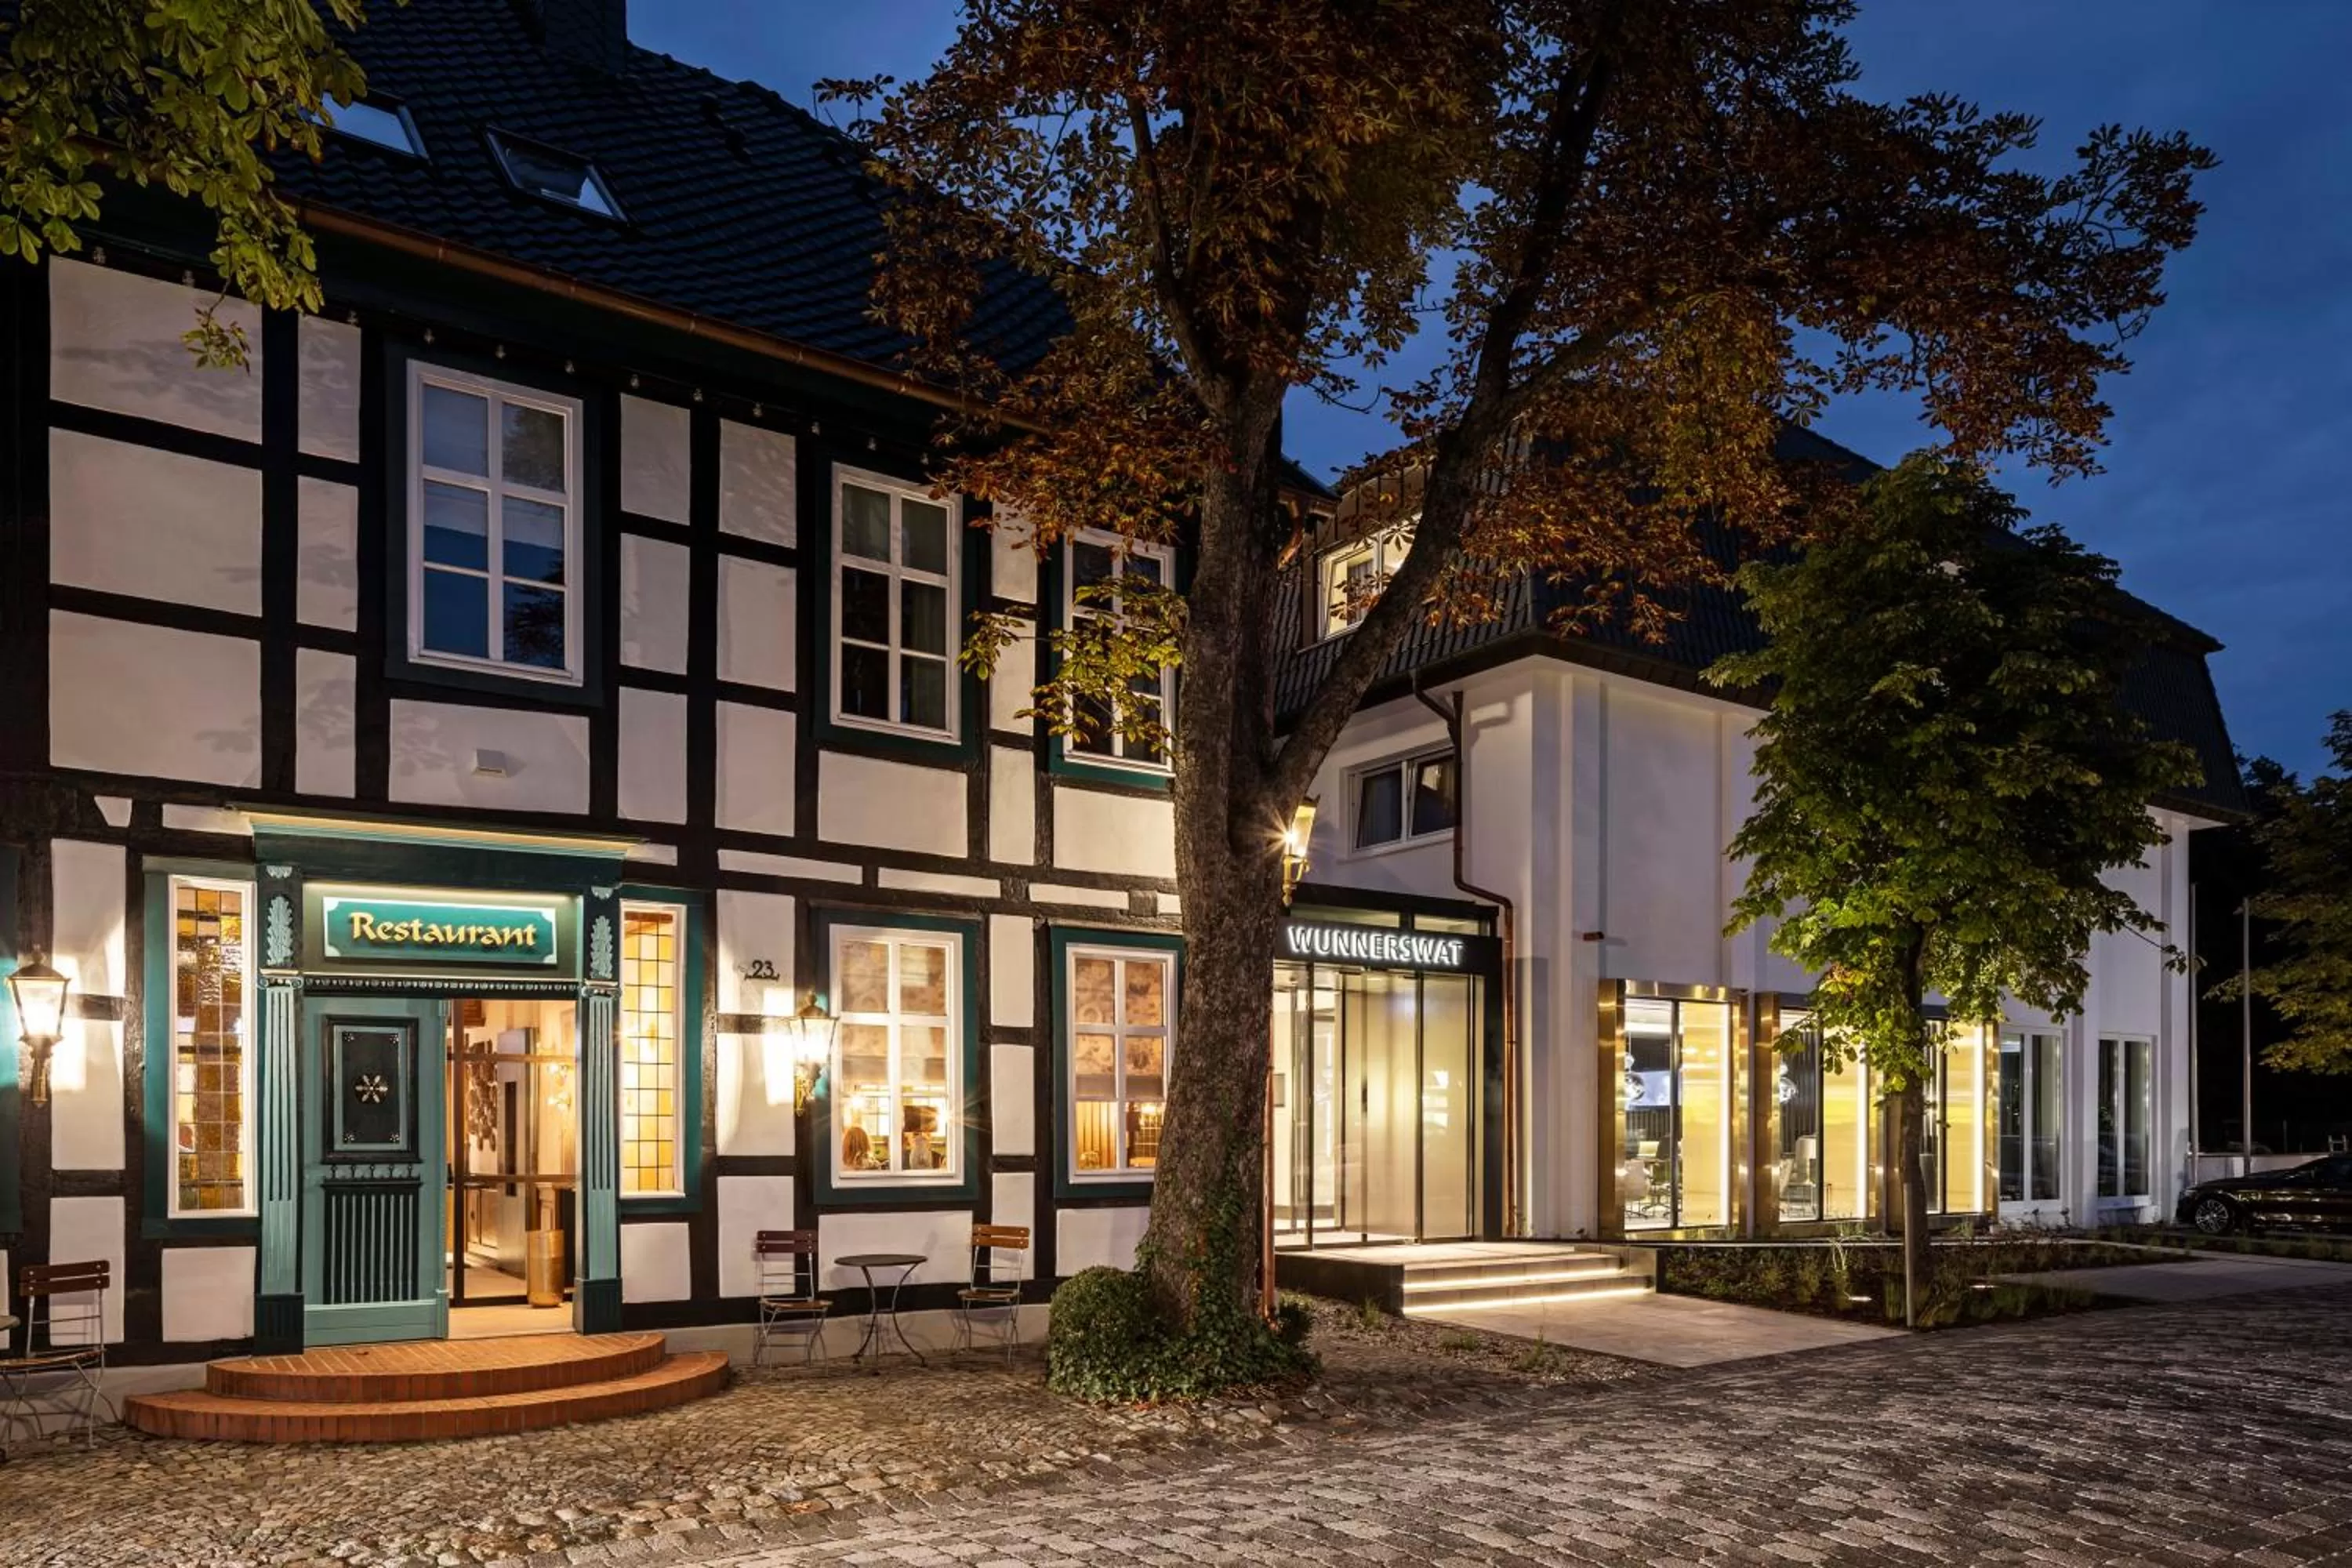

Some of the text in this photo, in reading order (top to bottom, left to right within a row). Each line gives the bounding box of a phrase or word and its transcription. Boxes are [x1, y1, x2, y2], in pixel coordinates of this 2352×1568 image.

[349, 911, 536, 946] Restaurant
[1287, 925, 1463, 965] WUNNERSWAT
[752, 959, 774, 978] 23
